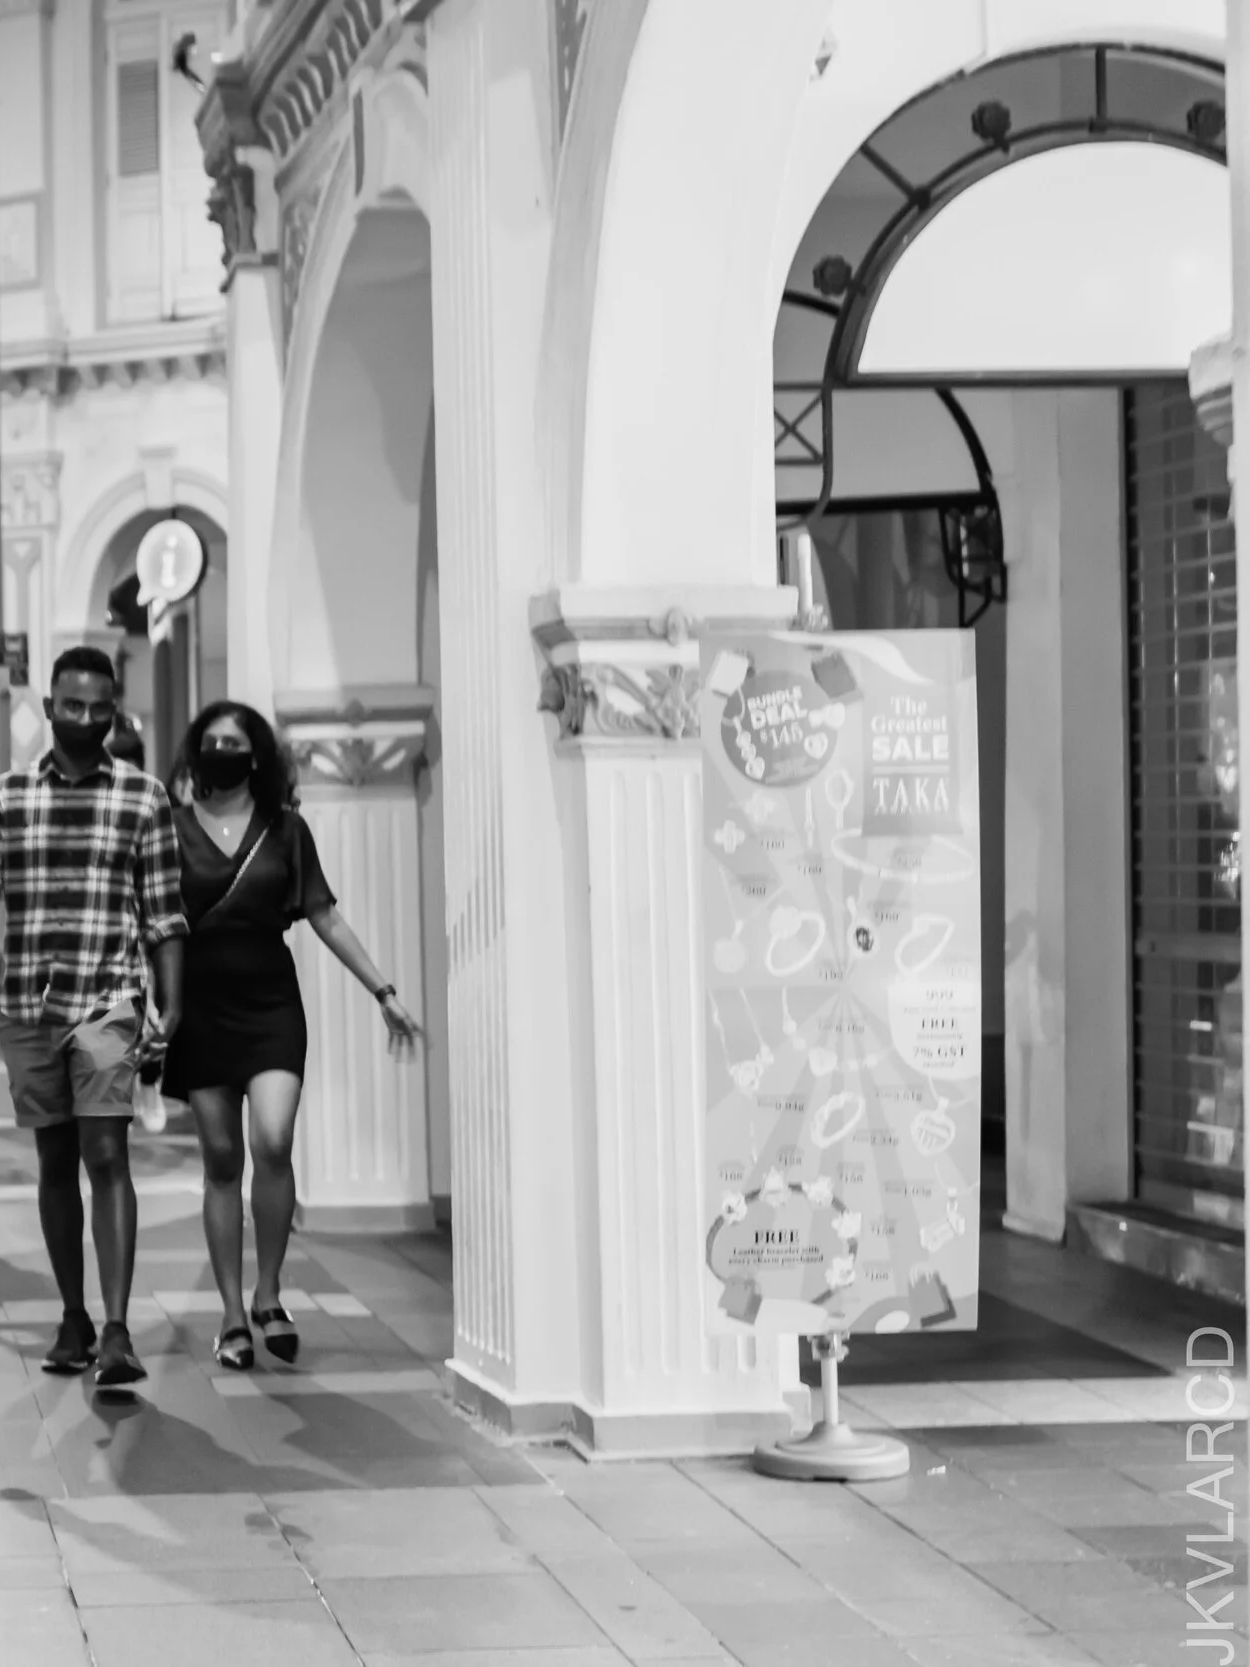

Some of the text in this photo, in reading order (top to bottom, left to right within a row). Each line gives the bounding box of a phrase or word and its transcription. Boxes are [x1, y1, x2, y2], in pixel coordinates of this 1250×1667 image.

[750, 701, 809, 731] DEAL
[890, 695, 928, 716] The
[871, 713, 948, 734] Greatest
[872, 734, 950, 762] SALE
[872, 777, 951, 814] TAKA
[920, 1016, 959, 1031] FREE
[753, 1229, 800, 1245] FREE
